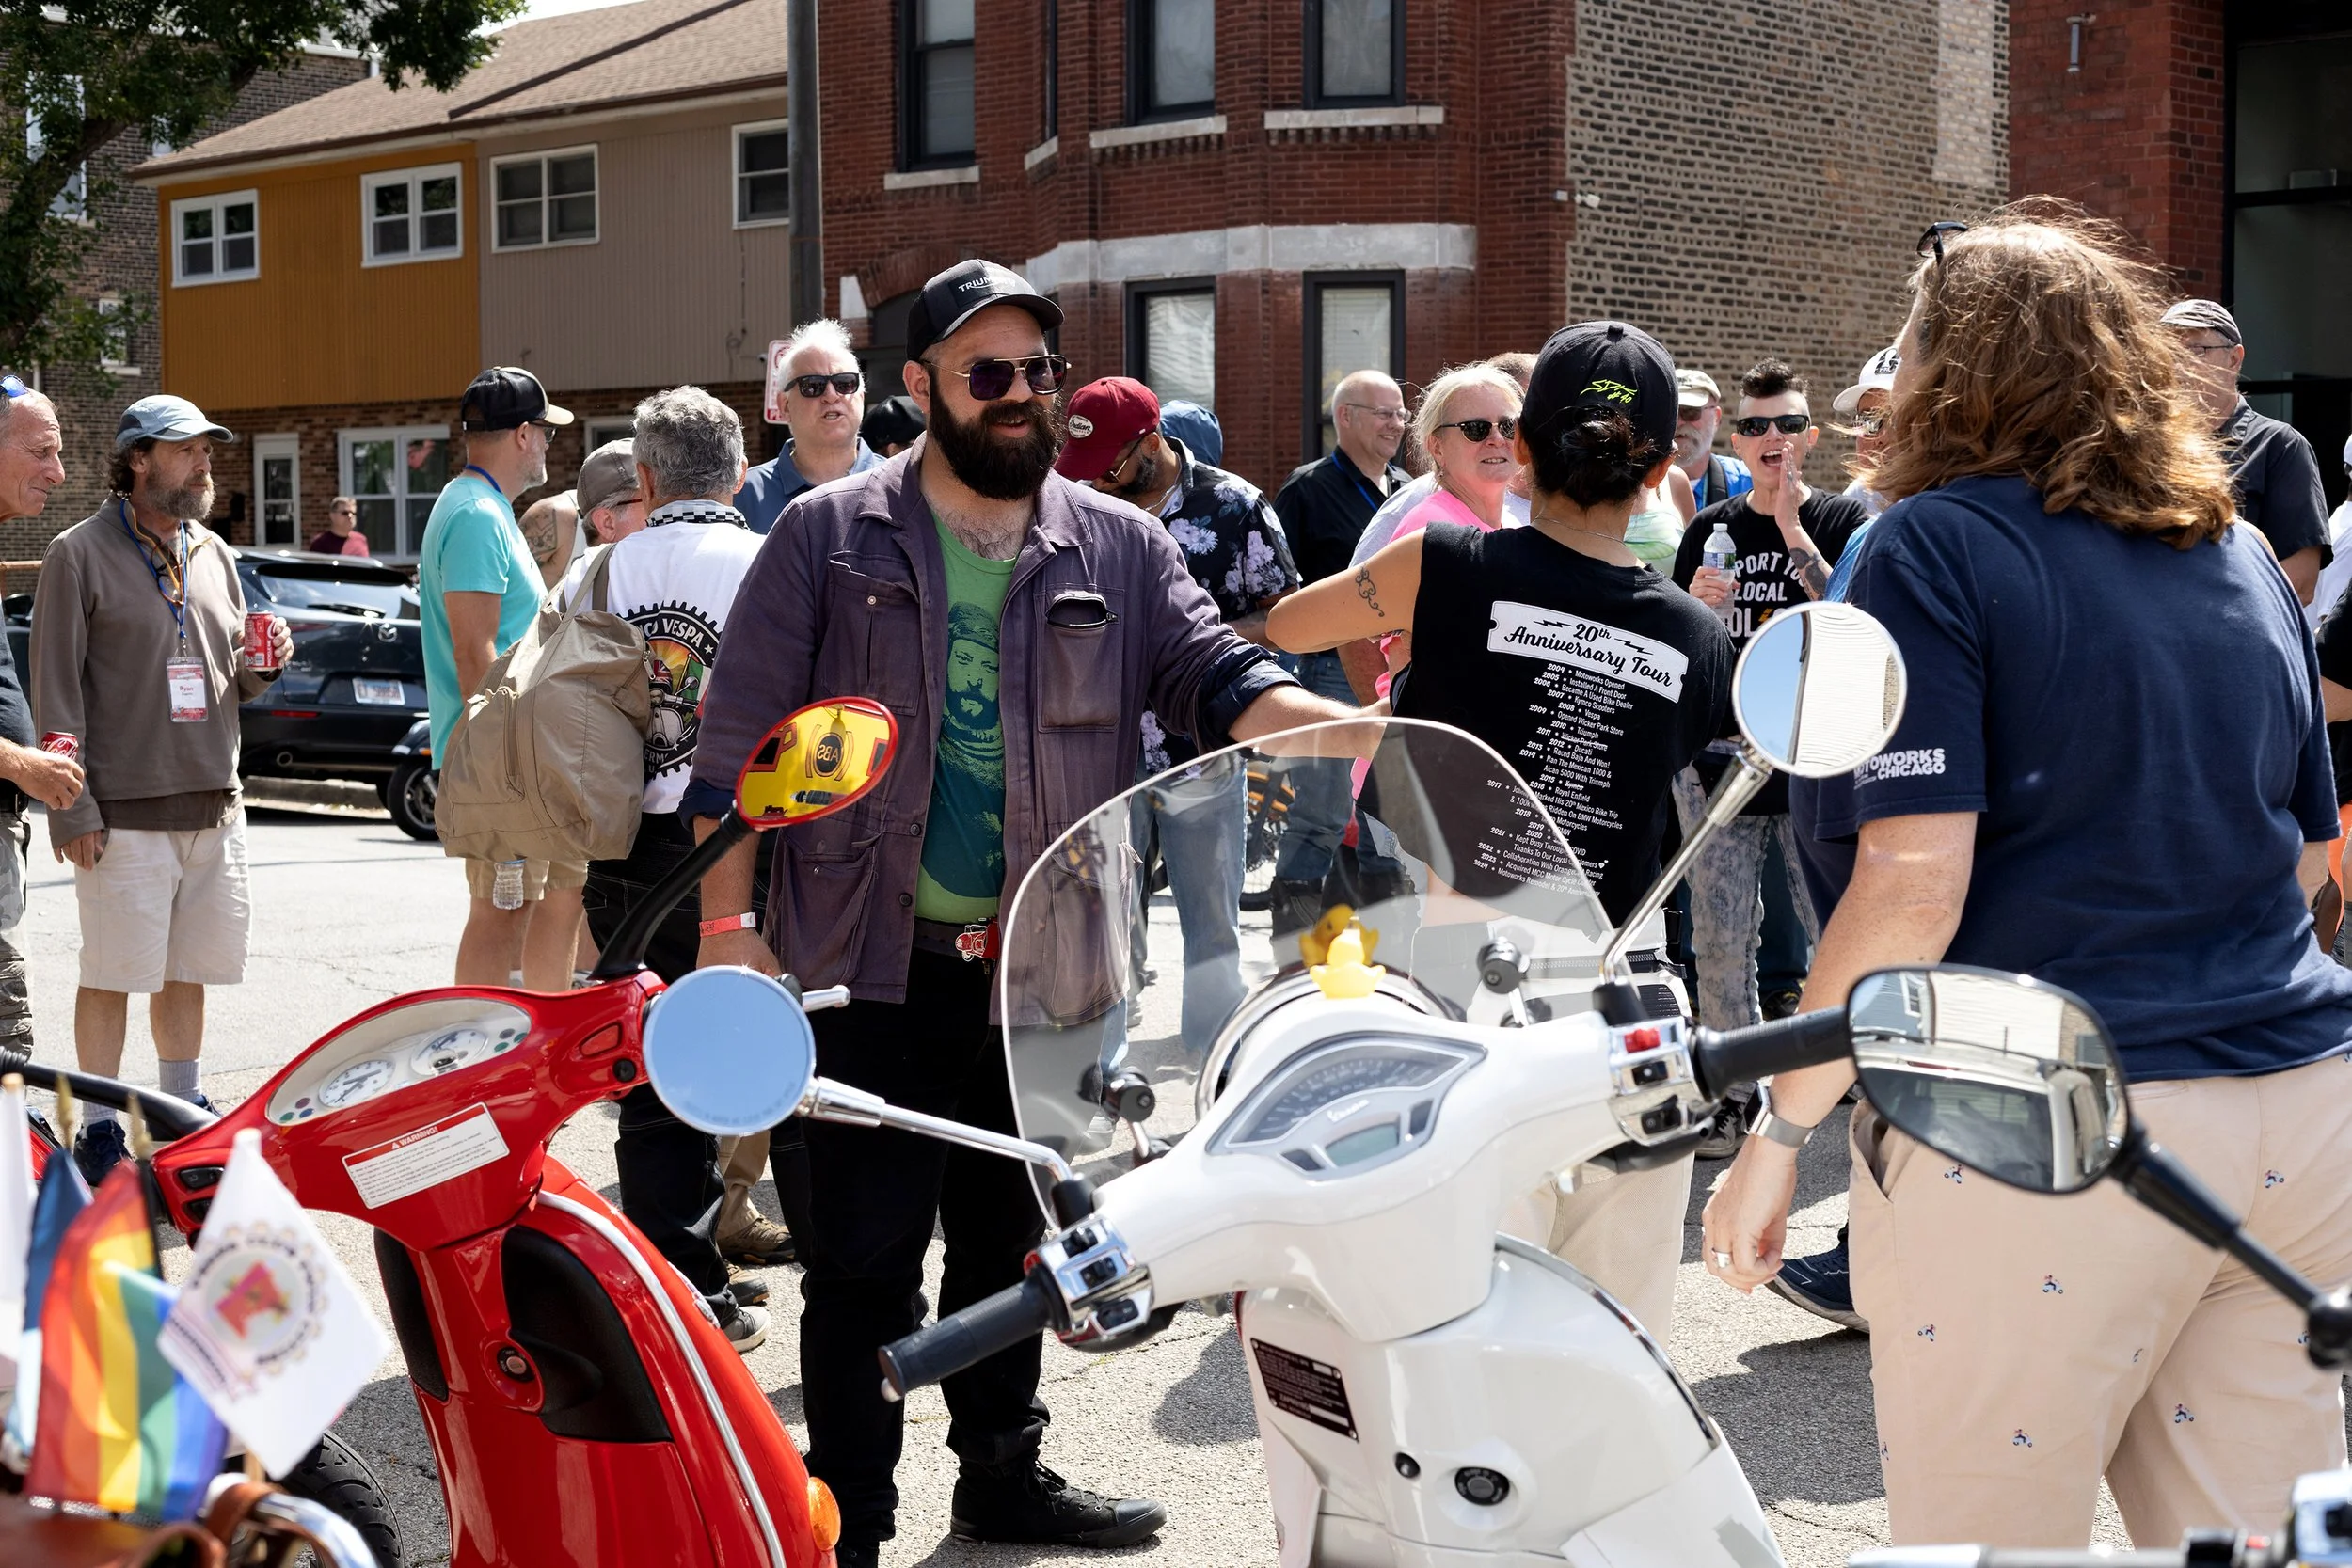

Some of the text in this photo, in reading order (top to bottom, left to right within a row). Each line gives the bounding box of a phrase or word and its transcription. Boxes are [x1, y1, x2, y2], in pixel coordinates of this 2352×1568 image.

[1733, 580, 1788, 602] LOCAL
[662, 618, 705, 648] VESPA
[1573, 623, 1612, 642] 20th
[1503, 626, 1673, 687] Anniversary Tour
[1542, 672, 1560, 681] 2005
[1569, 677, 1594, 690] Installed
[1599, 687, 1613, 696] Front
[1613, 690, 1627, 699] Door
[1547, 663, 1625, 690] 2004 Motoworks Opened
[1534, 677, 1550, 687] 2006
[1562, 684, 1583, 696] Became
[1589, 691, 1602, 702] Used
[1603, 696, 1615, 705] Bike
[1615, 700, 1633, 710] Dealer
[1547, 689, 1615, 714] 2007 Kymco Scooters
[1529, 705, 1624, 736] 2009 Opened Wicker Park Store
[1558, 702, 1601, 720] 2008 Vespa
[1536, 727, 1608, 752] 2011 Wicker Park Store
[1550, 721, 1599, 739] 2010 Triumph
[1527, 741, 1611, 768] 2013 Raced Baja And Won!
[1549, 738, 1593, 756] 2012 Ducati
[1519, 749, 1535, 758] 2014
[1547, 754, 1557, 764] Ran
[1558, 759, 1568, 768] The
[1568, 761, 1592, 773] Mexican
[1593, 768, 1606, 777] 1000
[1877, 763, 1946, 780] CHICAGO
[1539, 774, 1555, 784] 2015
[1543, 765, 1611, 788] Alcan 5000 With Triumph
[1486, 779, 1502, 789] 2017
[1534, 791, 1554, 803] Marked
[1555, 797, 1565, 805] His
[1565, 800, 1576, 808] 20th
[1576, 803, 1594, 814] Mexico
[1595, 806, 1607, 816] Bike
[1608, 810, 1618, 819] Trip
[1530, 781, 1591, 802] 2016 Royal Enfield
[1515, 808, 1532, 818] 2018
[1557, 816, 1587, 831] Motorcycles
[1528, 822, 1544, 831] 2019
[1549, 805, 1567, 816] Ridden
[1568, 810, 1577, 818] On
[1578, 812, 1592, 822] BMW
[1592, 815, 1623, 830] Motorcycles
[1490, 827, 1506, 837] 2021
[1515, 834, 1529, 845] Kept
[1530, 839, 1543, 848] Busy
[1526, 830, 1543, 839] 2020
[1477, 842, 1493, 852] 2022
[1503, 850, 1540, 866] Collaboration
[1541, 862, 1553, 871] With
[1586, 869, 1603, 880] Racing
[1514, 844, 1534, 856] Thanks
[1542, 851, 1551, 860] Our
[1552, 853, 1567, 864] Loyal
[1473, 859, 1489, 869] 2024
[1498, 867, 1526, 883] Motoworks
[1526, 876, 1551, 890] Remodel
[1481, 853, 1497, 863] 2023
[1505, 862, 1531, 875] Acquired
[1532, 868, 1545, 878] MCC
[1545, 872, 1561, 882] Motor
[1562, 876, 1577, 885] Cycle
[399, 1126, 438, 1146] WARNING!
